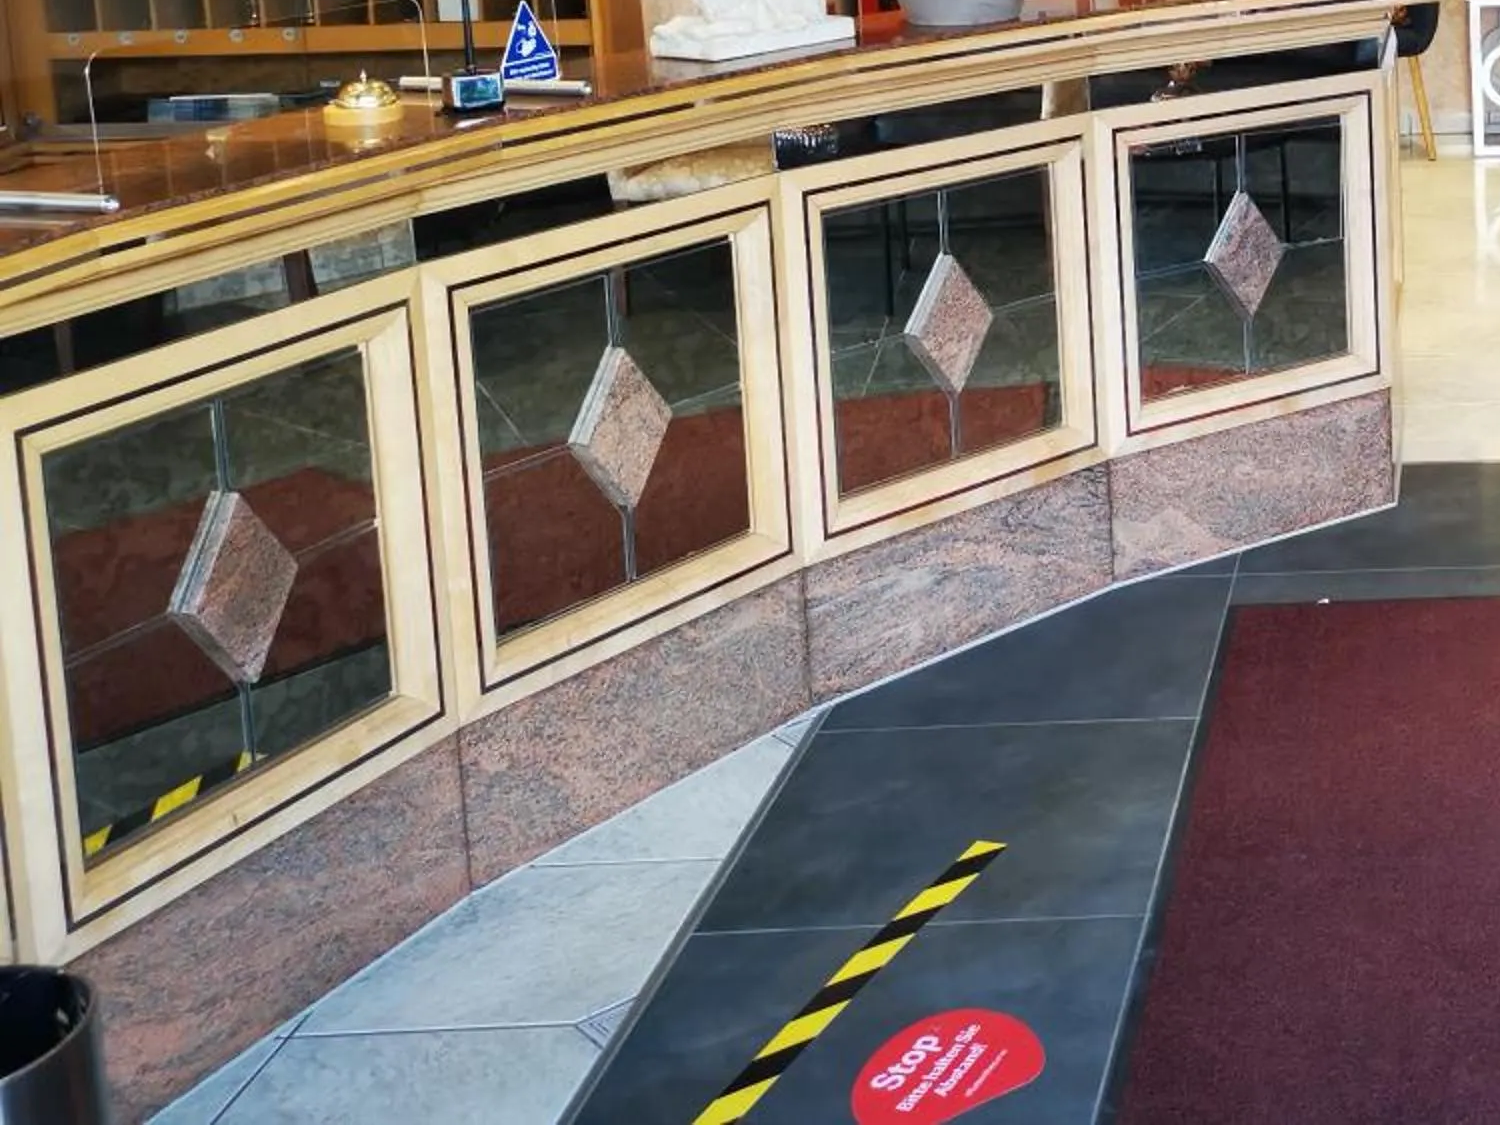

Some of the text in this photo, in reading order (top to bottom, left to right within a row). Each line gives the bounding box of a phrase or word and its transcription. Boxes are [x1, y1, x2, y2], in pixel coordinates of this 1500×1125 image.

[869, 1035, 943, 1091] Stop
[896, 1023, 981, 1112] Bitte halten Sie
